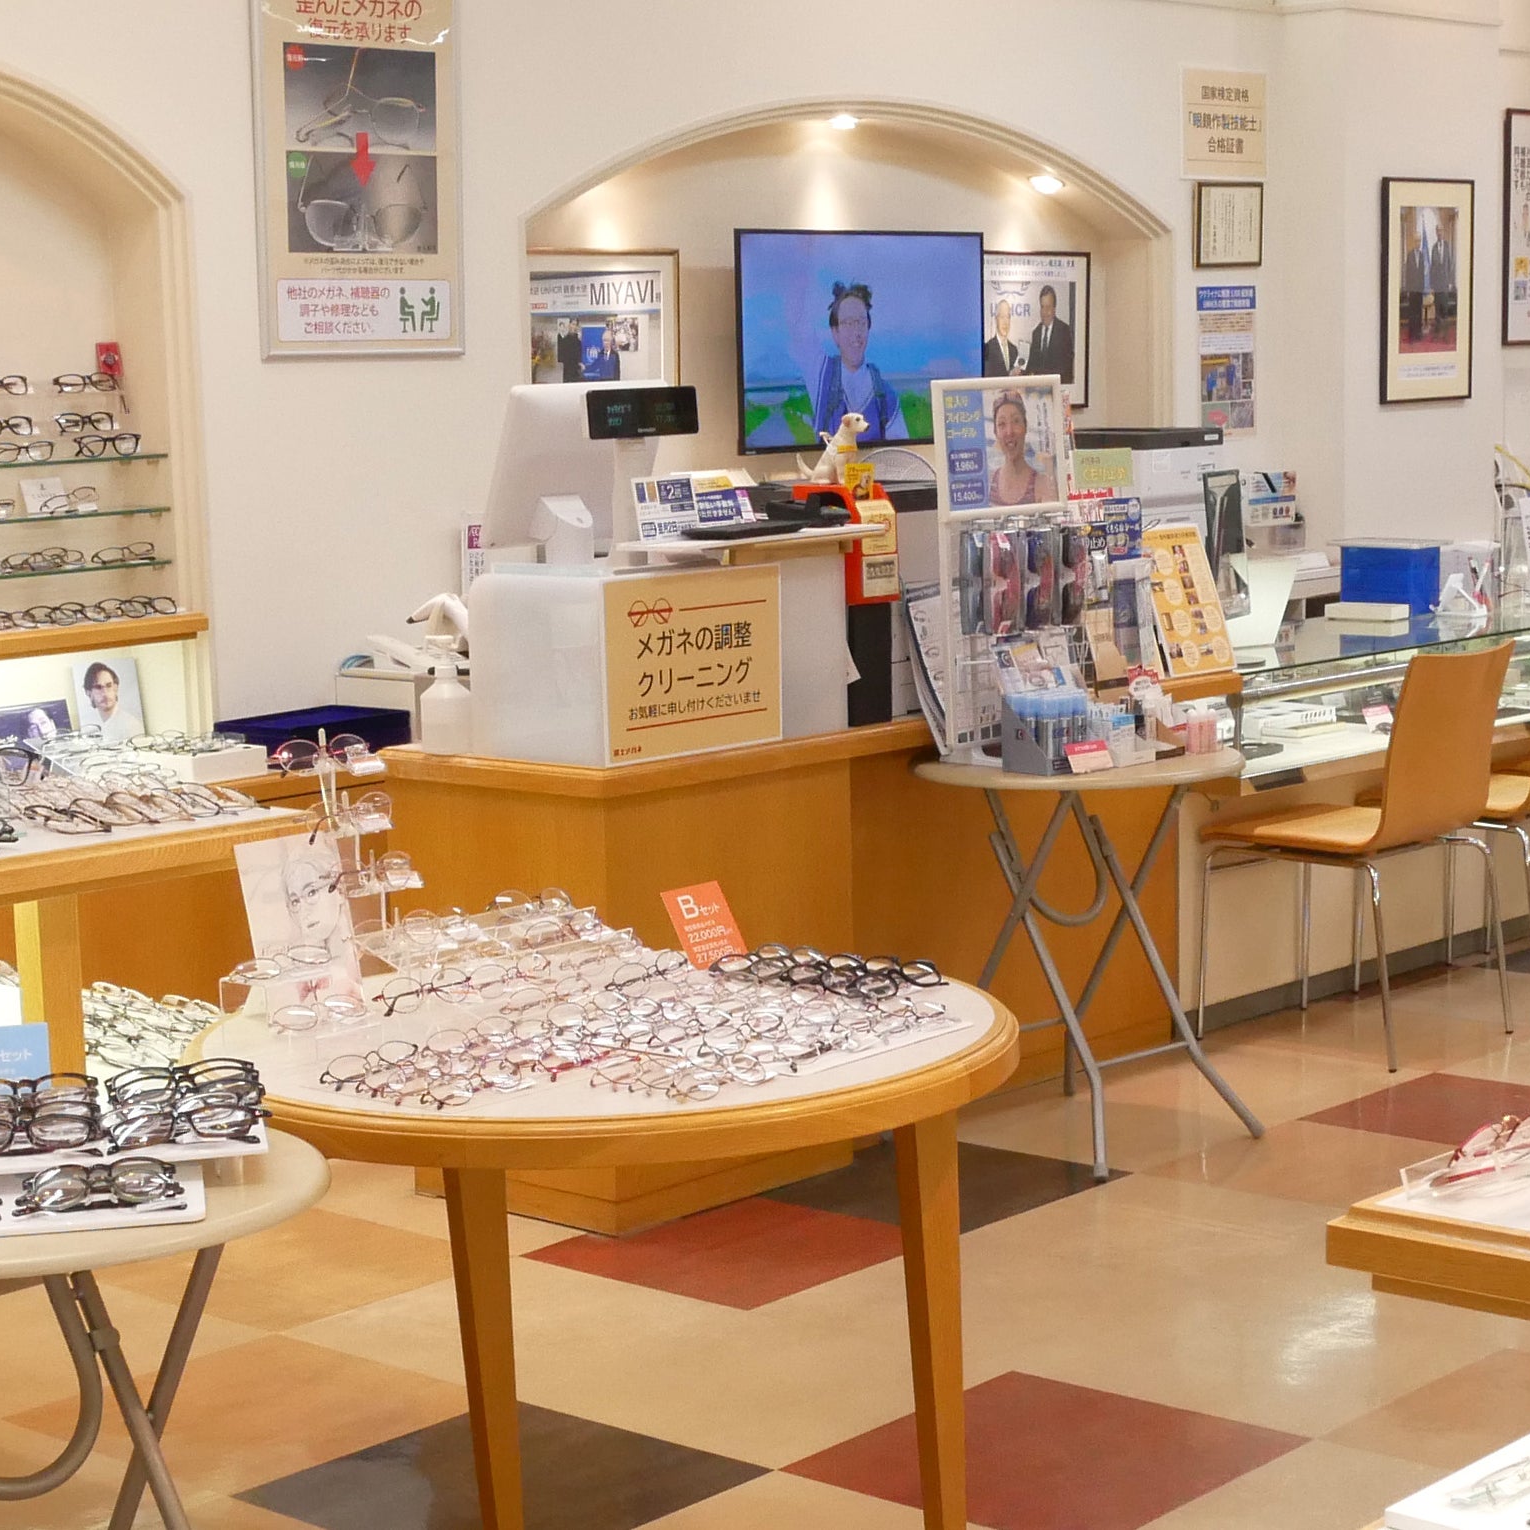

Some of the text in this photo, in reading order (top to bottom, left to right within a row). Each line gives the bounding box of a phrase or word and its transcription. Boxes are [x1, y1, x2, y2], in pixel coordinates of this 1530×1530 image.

[287, 286, 390, 300] 他社のメガネ、補聴器の
[590, 279, 654, 306] MIYAVI
[299, 304, 379, 317] 調子や修理なども
[636, 620, 753, 660] メガネの調整
[638, 656, 753, 698] クリーニング
[628, 690, 761, 721] お気軽に申し付けくださいませ
